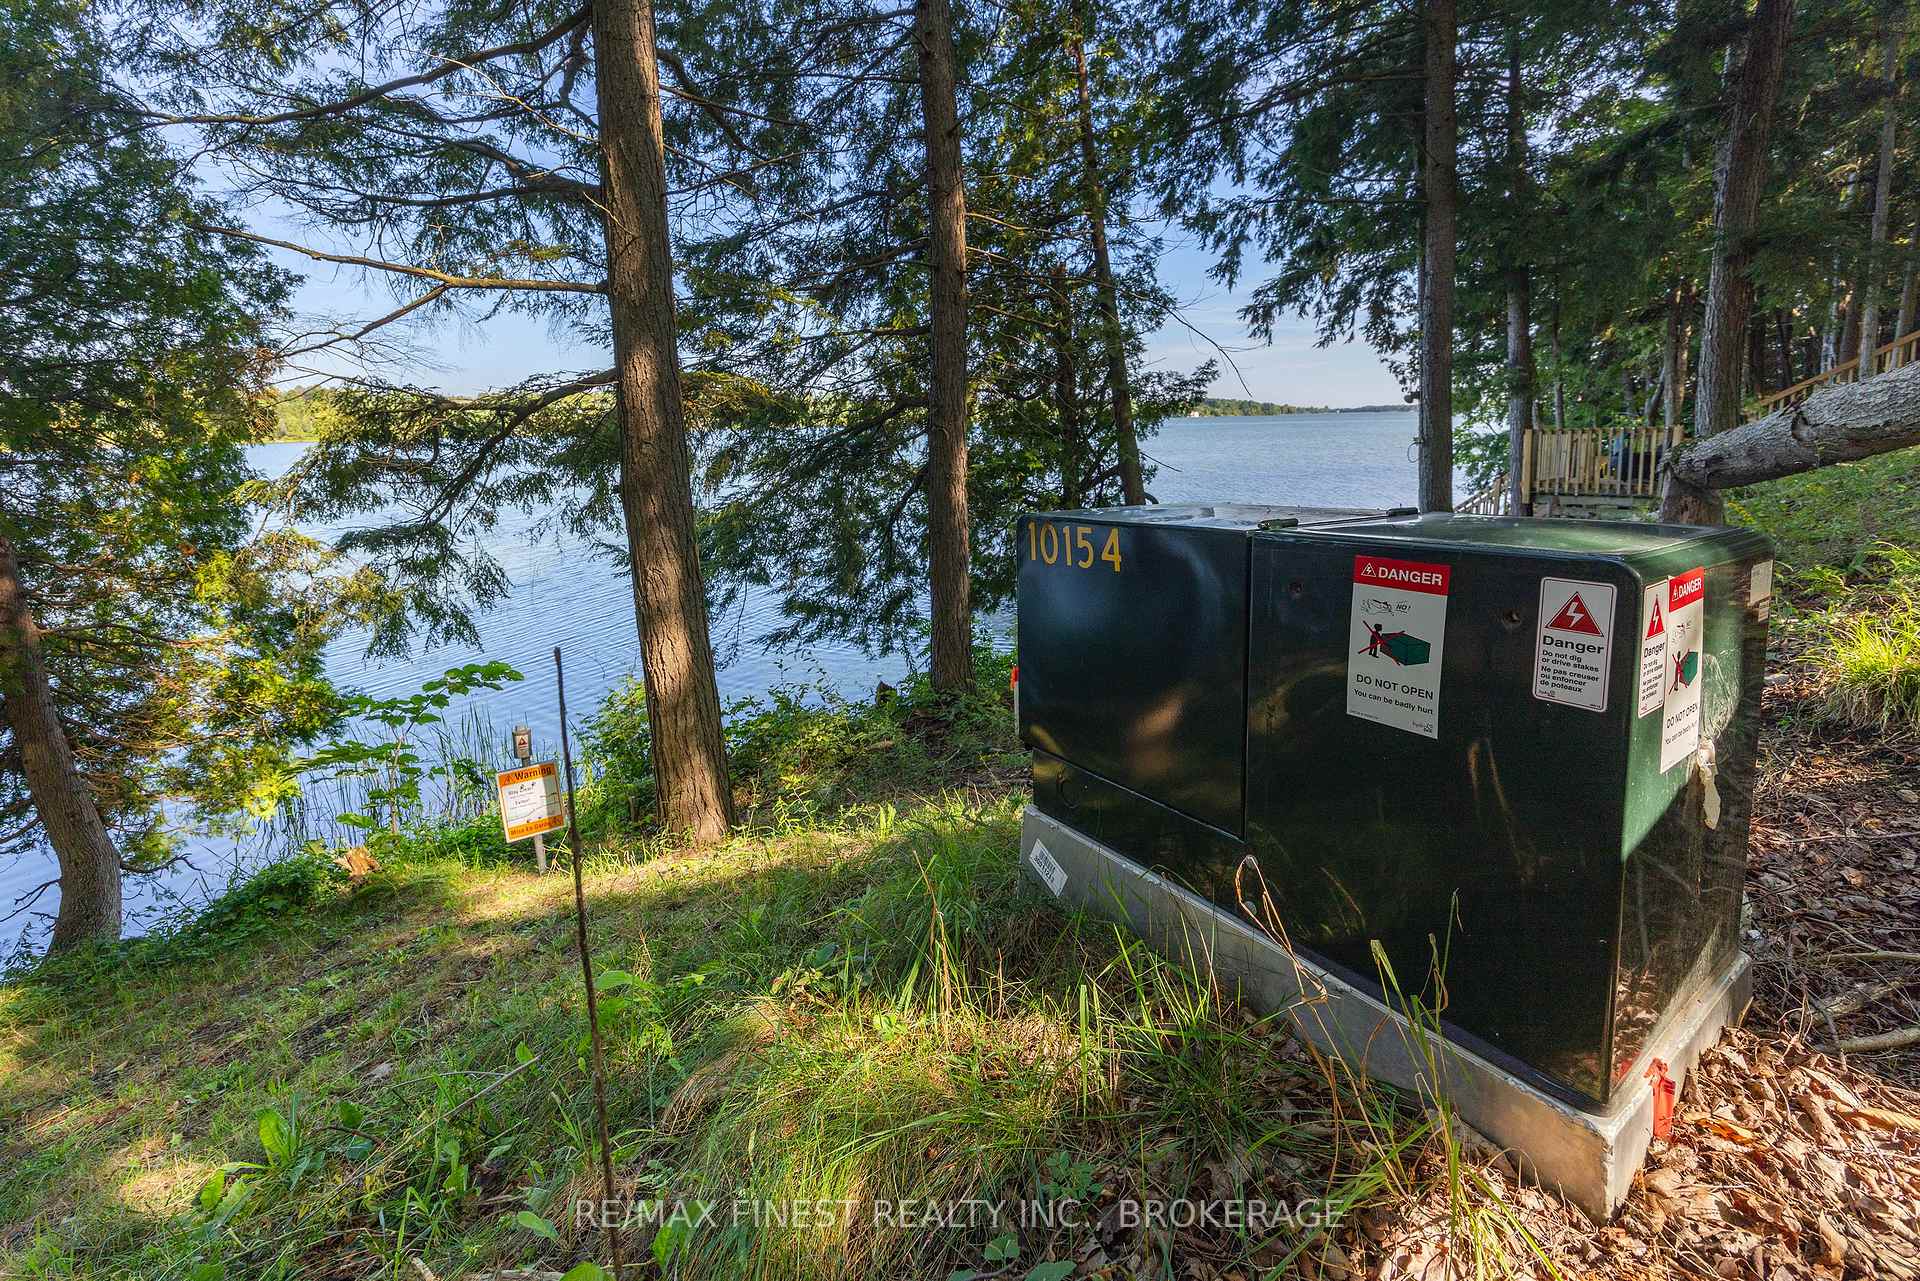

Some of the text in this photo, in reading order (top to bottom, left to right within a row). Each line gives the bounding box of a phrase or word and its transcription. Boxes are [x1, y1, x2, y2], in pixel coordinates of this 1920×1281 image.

[1027, 520, 1121, 573] 10154
[1378, 567, 1443, 586] DANGER
[1678, 577, 1702, 598] DANGER
[1543, 635, 1604, 654] Danger
[1644, 642, 1665, 658] Danger
[1542, 649, 1582, 663] Do not dig
[1541, 665, 1600, 682] Ne pas creuser
[1551, 658, 1571, 667] drive
[1572, 663, 1599, 673] stakes
[1356, 674, 1434, 700] DO NOT OPEN
[1551, 682, 1583, 693] poteaux
[1552, 675, 1587, 687] enfoncer
[1354, 688, 1367, 698] You
[1368, 693, 1382, 702] can
[1383, 697, 1393, 705] be
[1394, 700, 1416, 711] badly
[1667, 716, 1675, 729] DO
[1675, 709, 1685, 722] NOT
[514, 767, 552, 781] Warning
